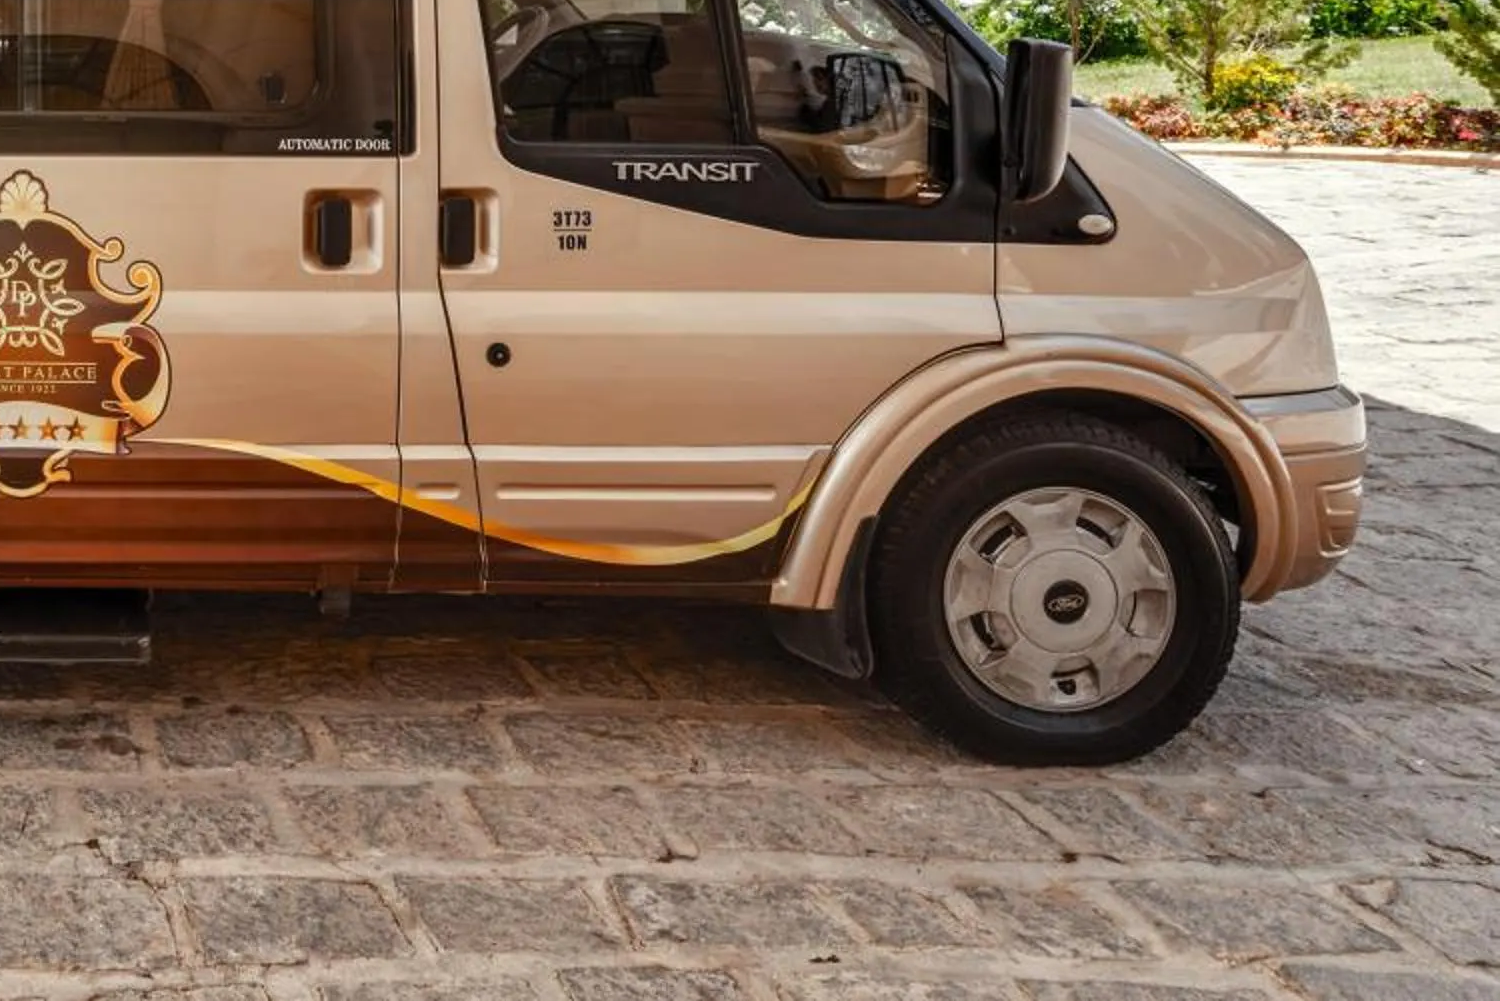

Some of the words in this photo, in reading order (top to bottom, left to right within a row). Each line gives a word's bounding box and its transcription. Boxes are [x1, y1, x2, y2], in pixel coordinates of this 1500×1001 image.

[278, 138, 352, 151] AUTOMATIC
[355, 138, 391, 151] DOOR
[612, 161, 760, 182] TRANSIT
[553, 210, 592, 228] 3T73
[557, 234, 588, 251] 10N
[22, 366, 97, 380] PALACE
